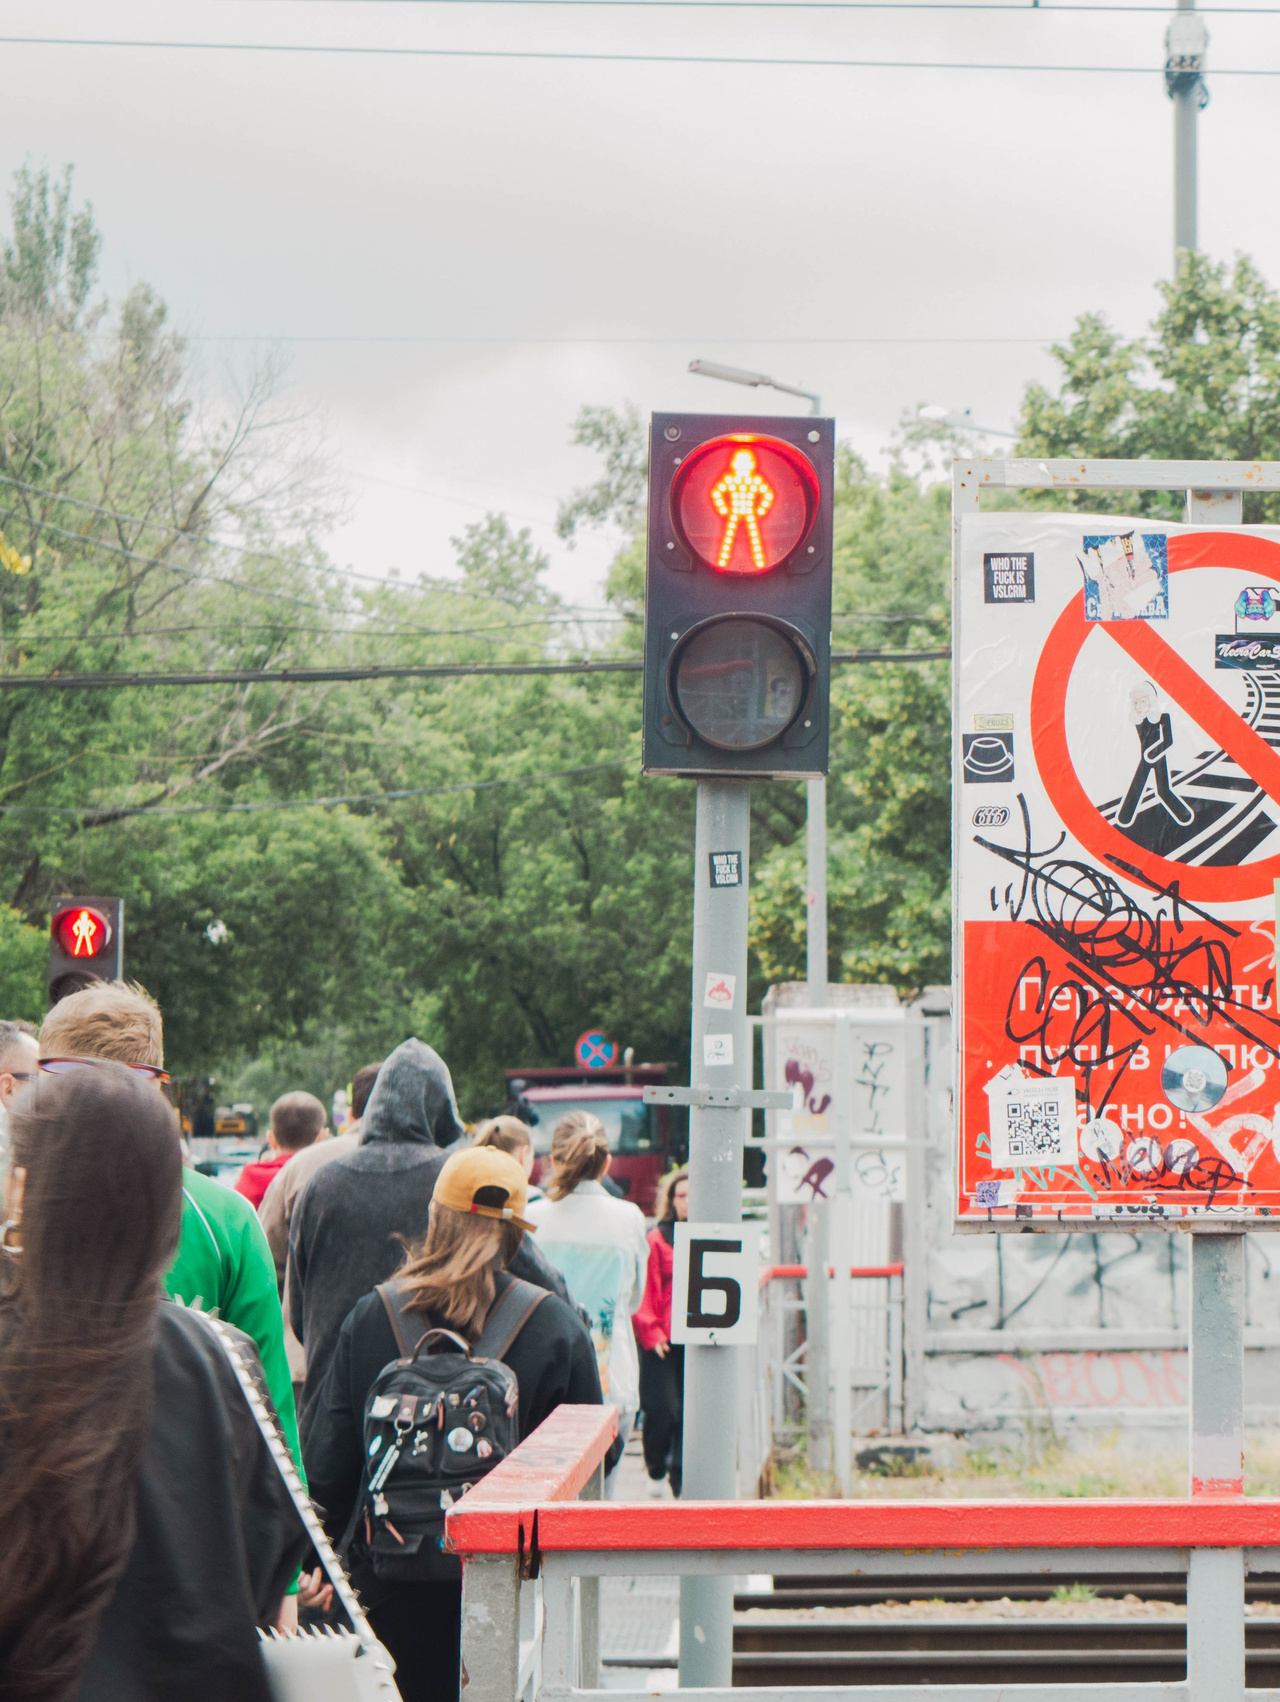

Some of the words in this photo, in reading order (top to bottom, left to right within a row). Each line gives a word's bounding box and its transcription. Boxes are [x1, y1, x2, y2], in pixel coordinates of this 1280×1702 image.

[990, 556, 1010, 571] WHO
[1010, 556, 1028, 570] THE
[993, 570, 1015, 585] FUCK
[1016, 570, 1025, 585] IS
[992, 584, 1027, 599] VSLCRM
[713, 855, 727, 865] WHO
[727, 853, 738, 864] THE
[715, 864, 731, 875] FUCK
[731, 863, 738, 874] IS
